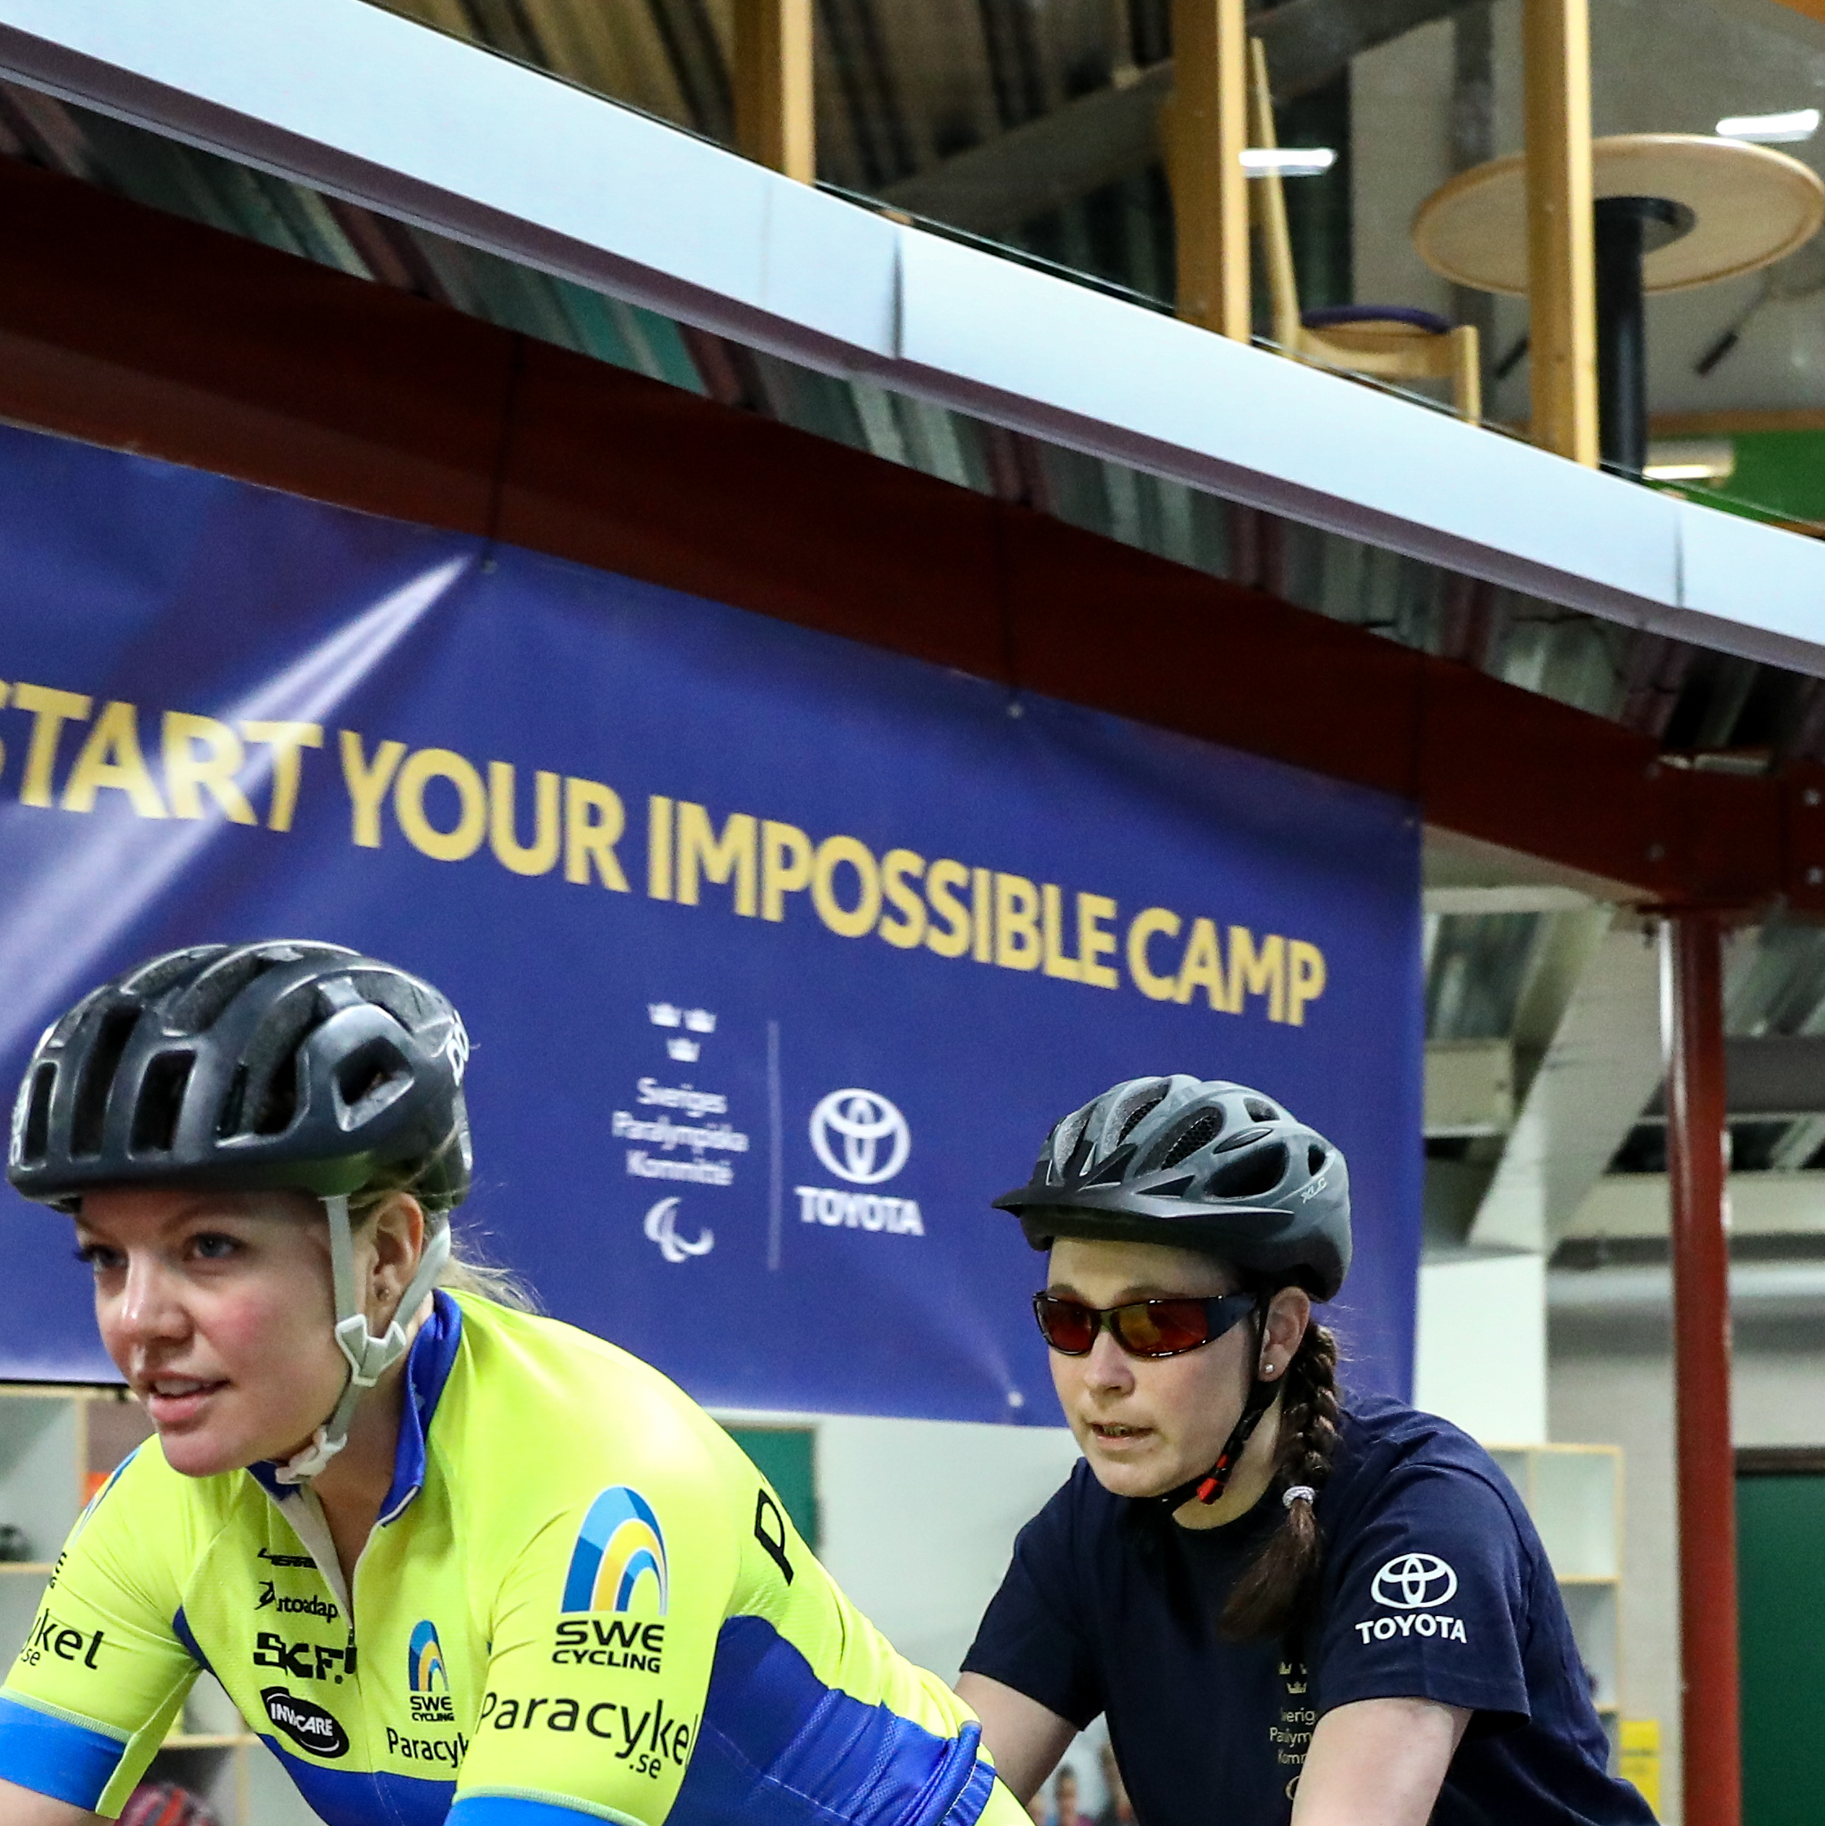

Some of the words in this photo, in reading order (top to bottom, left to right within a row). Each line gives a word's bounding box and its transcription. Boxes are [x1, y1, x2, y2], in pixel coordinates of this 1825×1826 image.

[338, 729, 631, 893] YOUR
[647, 793, 1119, 989] IMPOSSIBLE
[1126, 906, 1326, 1026] CAMP
[794, 1185, 925, 1236] TOYOTA
[555, 1619, 665, 1653] SWE
[1354, 1613, 1468, 1645] TOYOTA
[551, 1649, 661, 1674] CYCLING
[410, 1695, 453, 1711] SWE
[411, 1711, 455, 1722] CYCLING
[628, 1752, 662, 1780] .se
